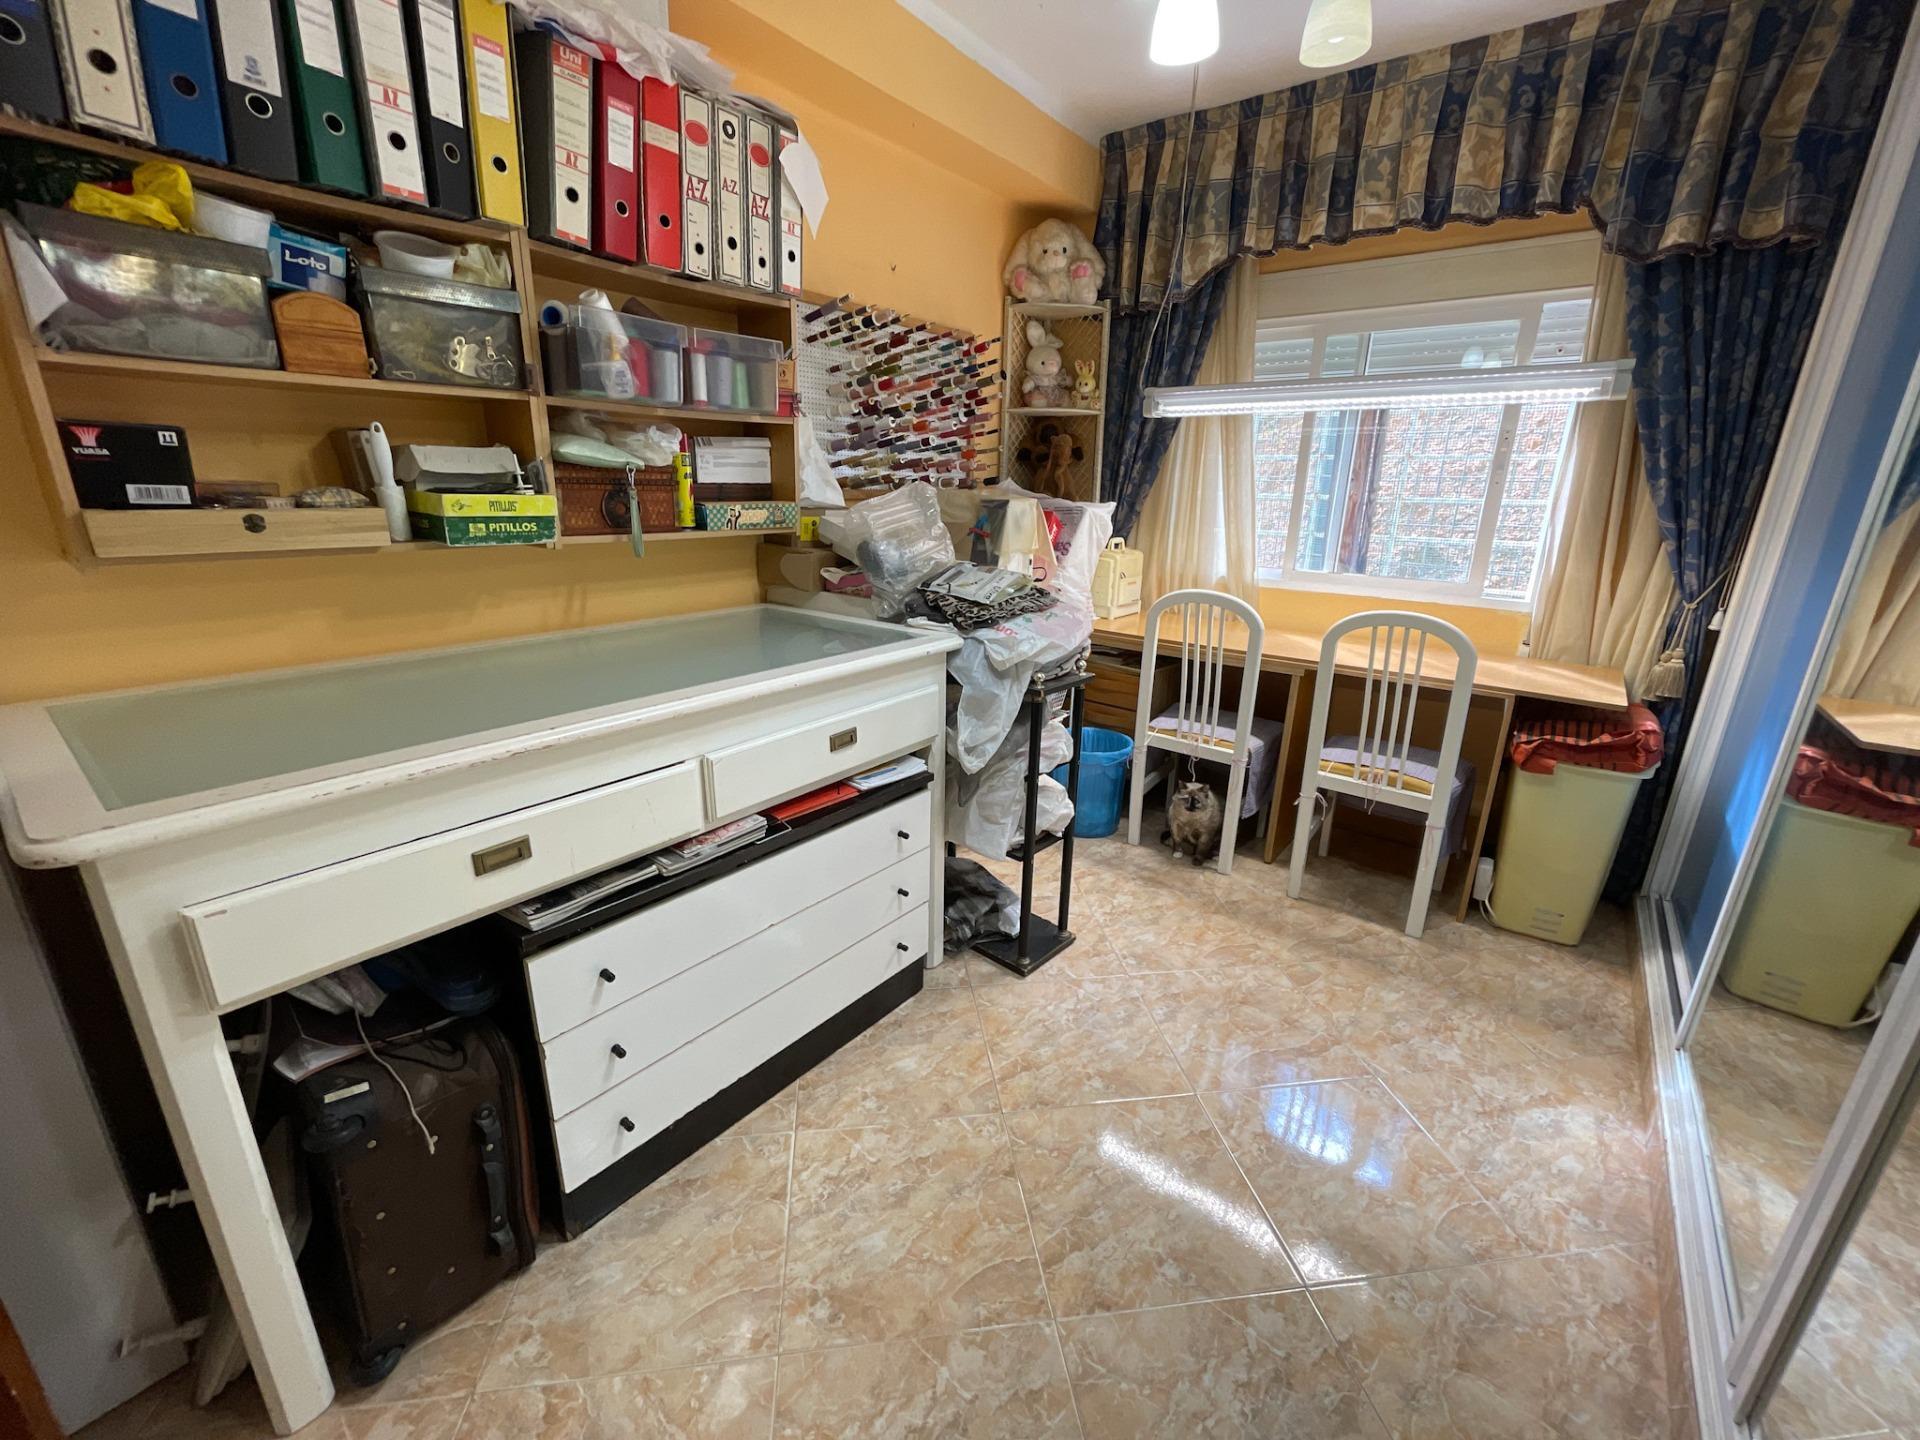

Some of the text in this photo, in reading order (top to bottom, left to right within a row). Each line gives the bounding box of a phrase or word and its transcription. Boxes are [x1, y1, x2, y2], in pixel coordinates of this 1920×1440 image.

[560, 45, 582, 65] Uni
[686, 175, 709, 203] A-Z
[721, 176, 739, 196] A-Z
[751, 194, 770, 219] A-Z
[284, 248, 327, 271] Loto
[71, 446, 111, 456] YUASA
[487, 499, 519, 513] PITILLOS
[489, 522, 538, 533] PITILLOS
